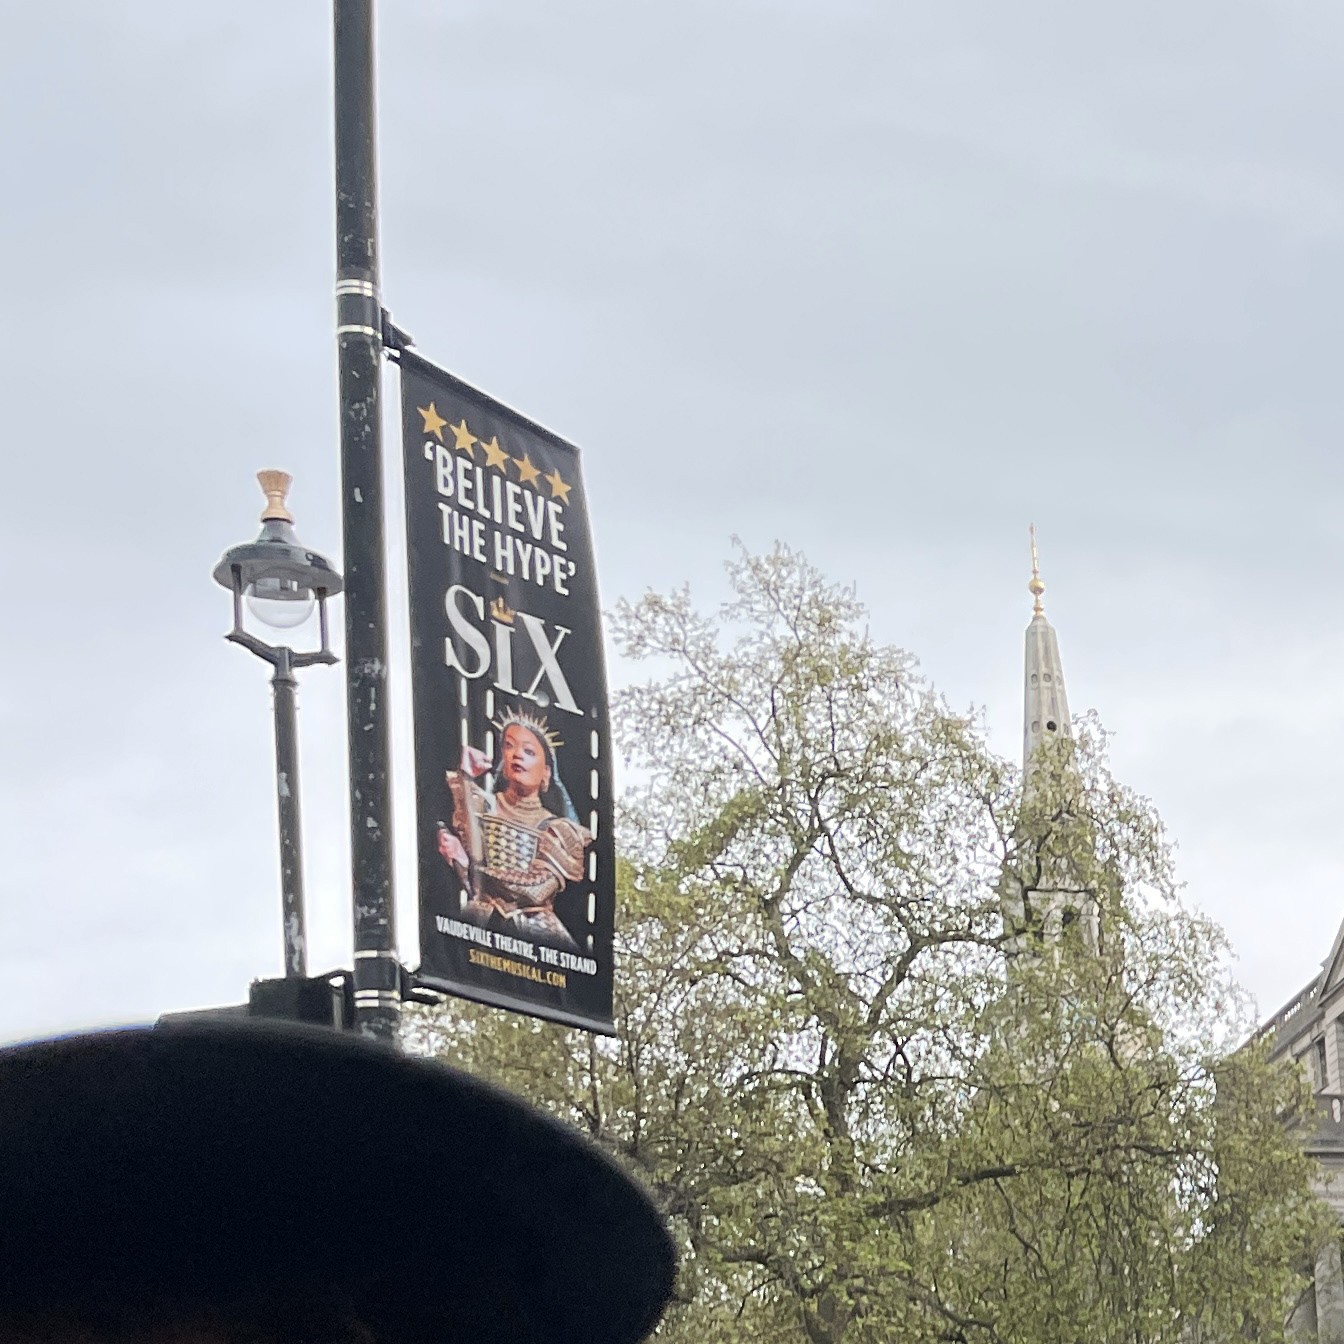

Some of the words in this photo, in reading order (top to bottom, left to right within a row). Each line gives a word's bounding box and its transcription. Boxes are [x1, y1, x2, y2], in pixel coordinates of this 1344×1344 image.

[438, 502, 487, 563] THE
[435, 915, 492, 948] VAUDEVILLE
[494, 933, 538, 962] THEATRE,
[539, 947, 560, 966] THE
[560, 952, 598, 976] STRAND
[469, 949, 566, 988] SIXTHEMUSICAL.COM
